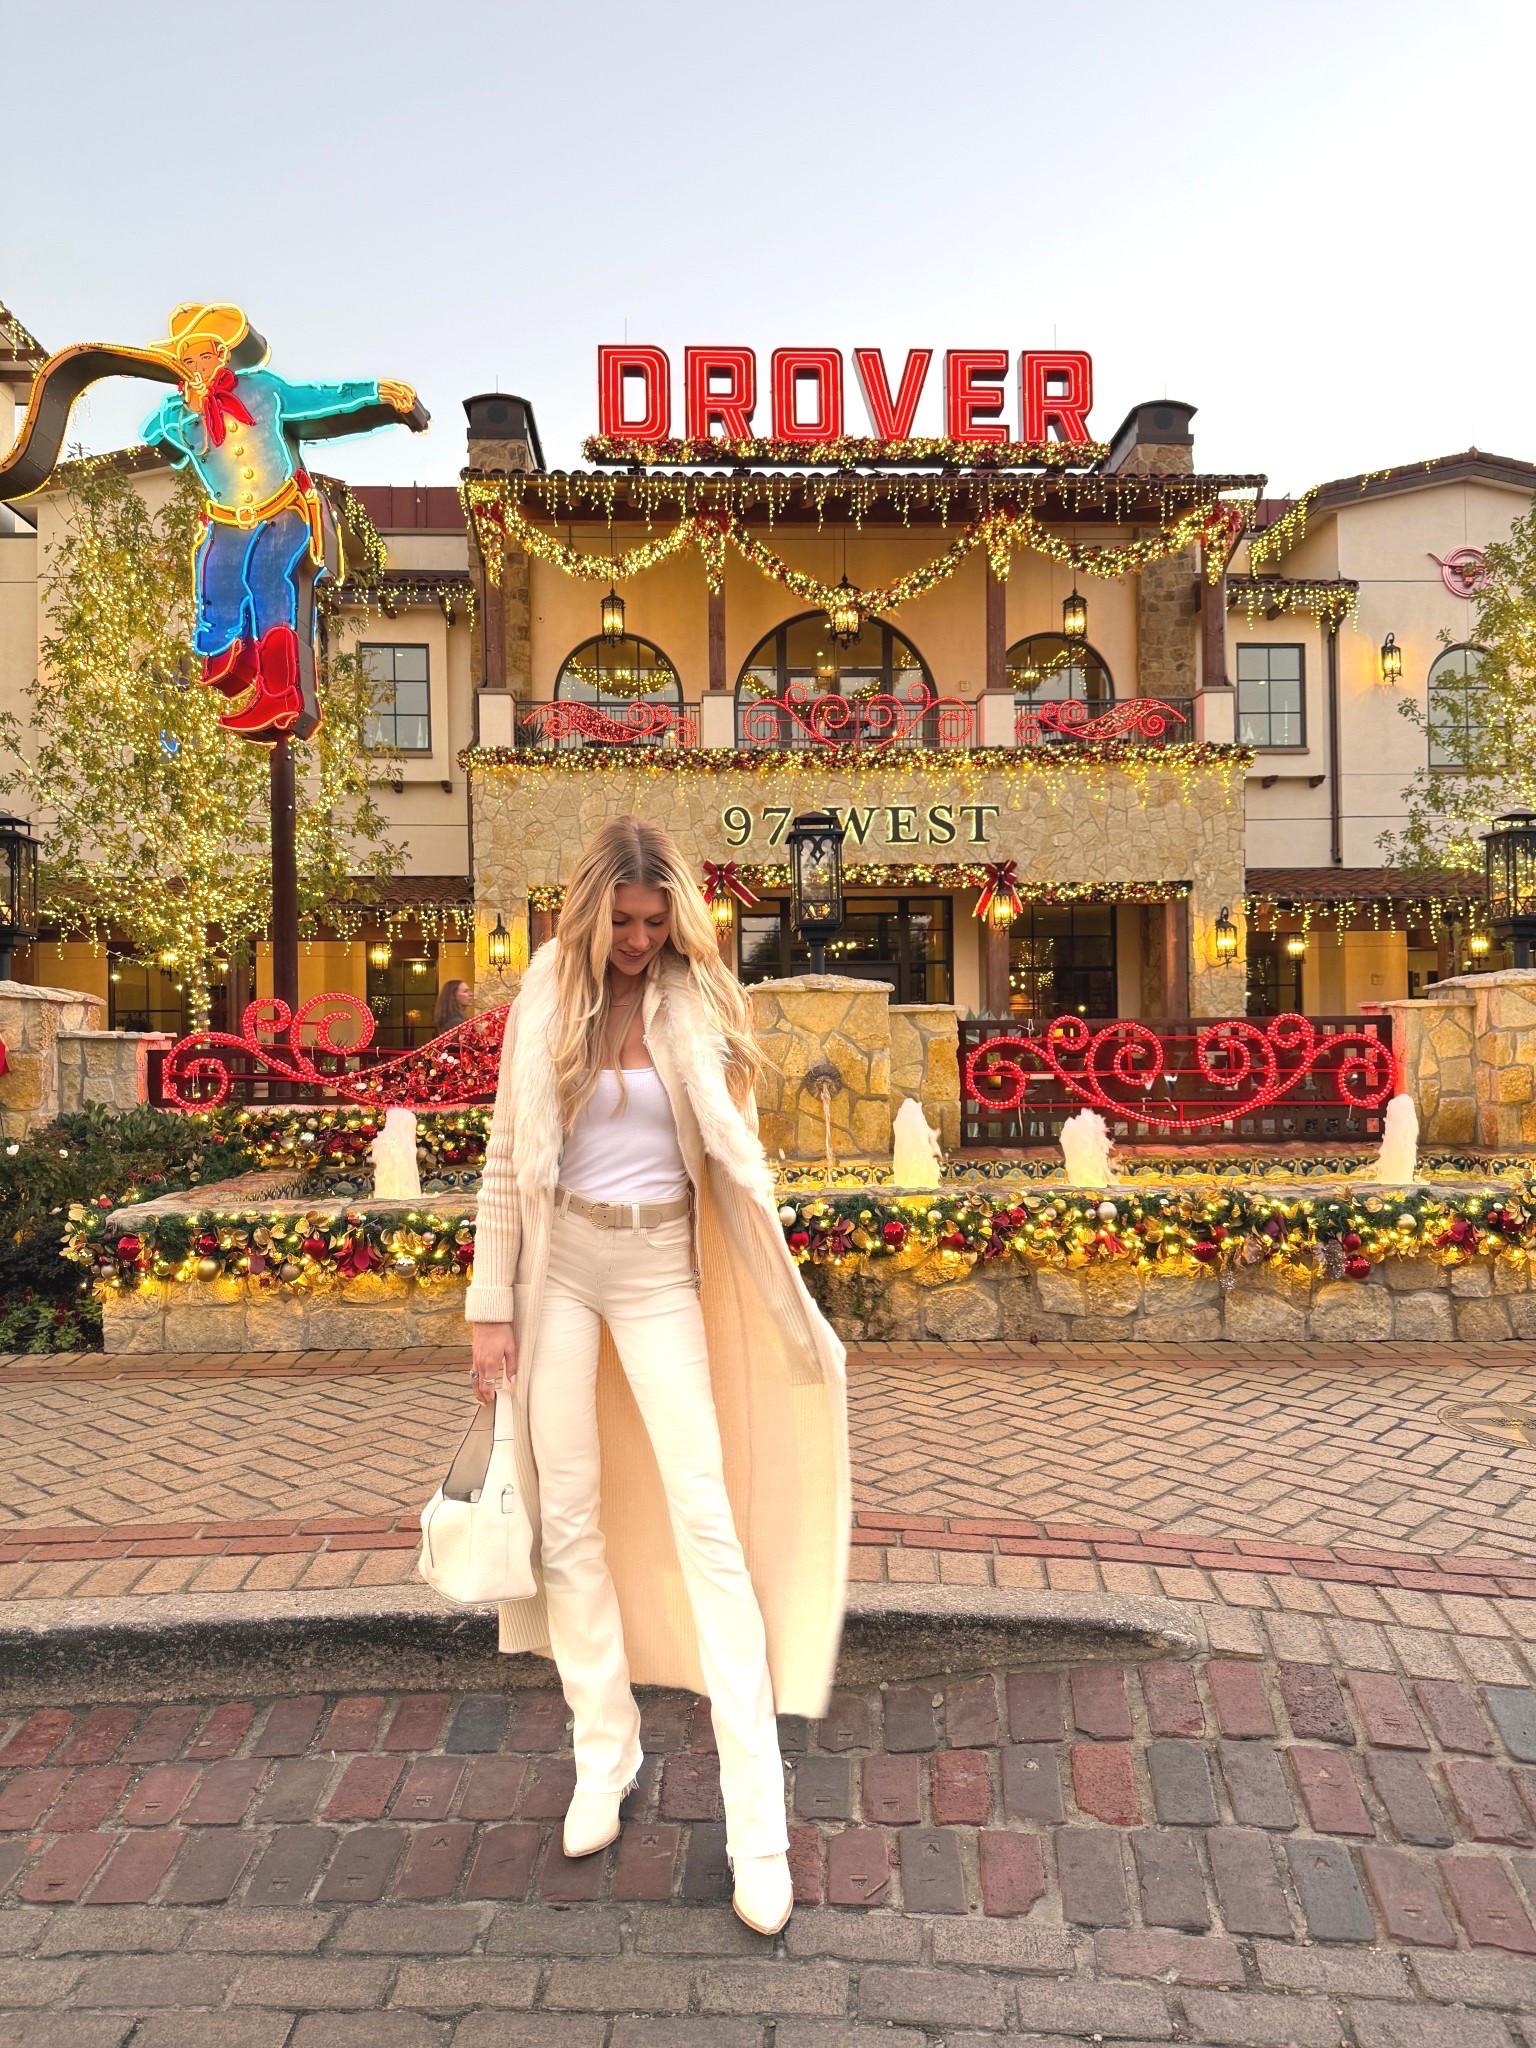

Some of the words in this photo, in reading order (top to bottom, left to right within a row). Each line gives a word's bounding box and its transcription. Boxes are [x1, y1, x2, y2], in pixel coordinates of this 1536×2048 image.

[597, 345, 1094, 444] DROVER
[723, 805, 792, 846] 97
[822, 805, 1000, 845] WEST
